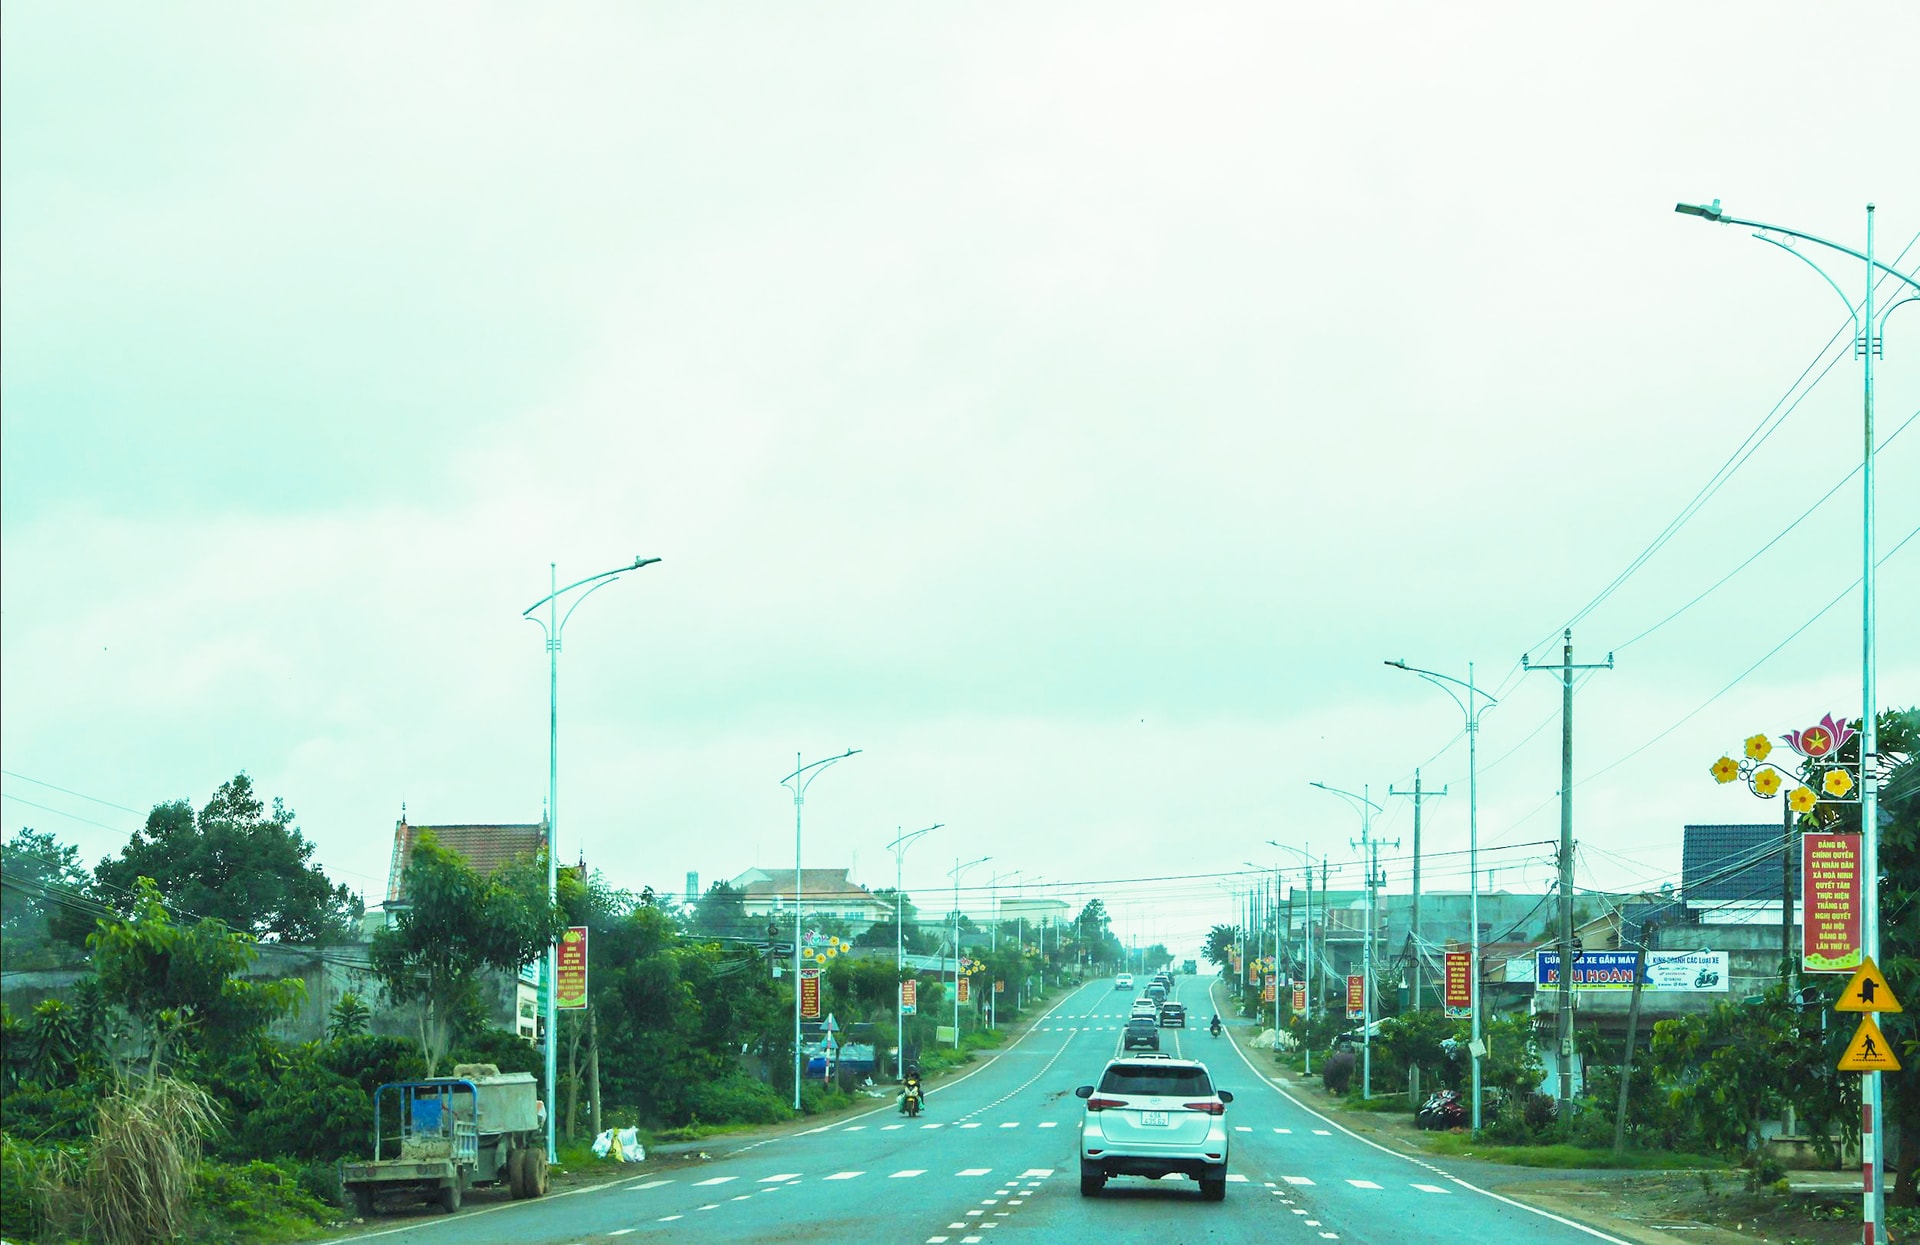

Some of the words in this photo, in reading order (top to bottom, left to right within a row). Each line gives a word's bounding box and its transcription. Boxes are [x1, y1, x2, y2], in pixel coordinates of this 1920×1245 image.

[1816, 881, 1835, 889] QUYẾT
[1817, 892, 1832, 900] THỰC
[1834, 892, 1849, 900] HIỆN
[1832, 911, 1851, 920] QUYẾT
[1545, 955, 1560, 963] CỬA
[1618, 955, 1635, 964] MÁY
[1687, 956, 1697, 964] CÁC
[1587, 967, 1633, 982] HOÀN
